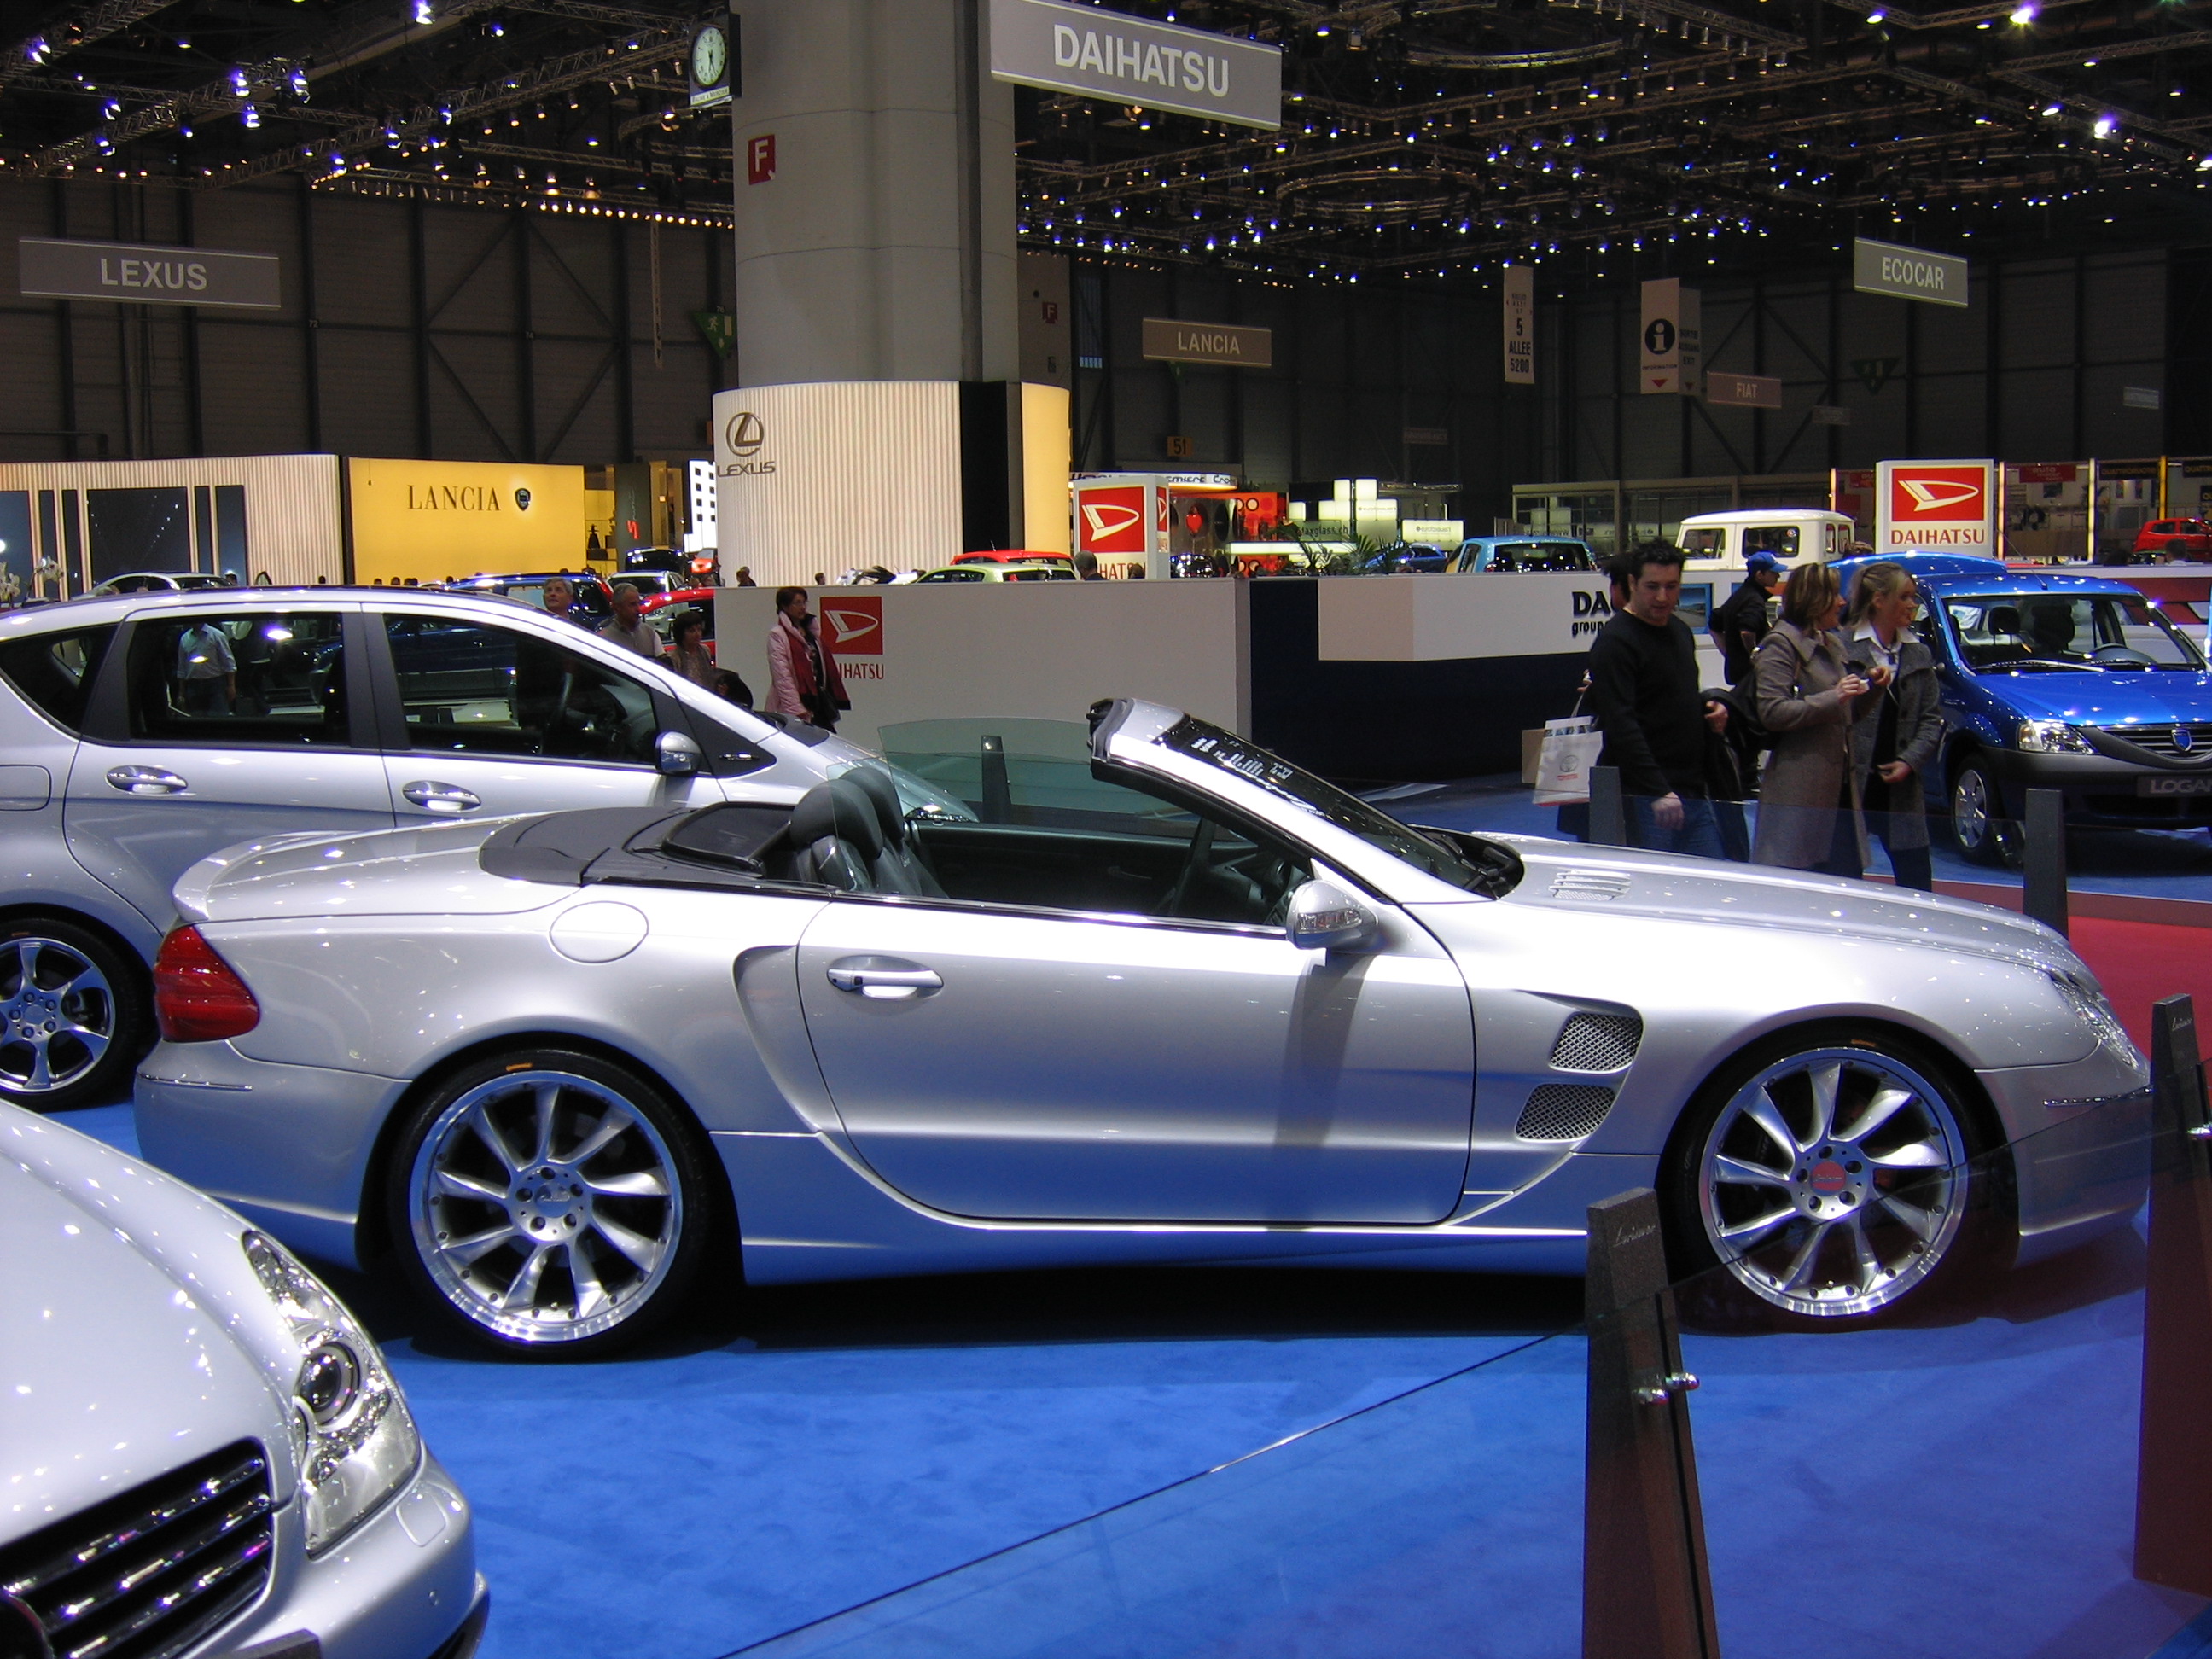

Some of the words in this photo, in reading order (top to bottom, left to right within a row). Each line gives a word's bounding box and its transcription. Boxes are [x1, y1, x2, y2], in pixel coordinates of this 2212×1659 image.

[1053, 24, 1230, 98] DAIHATSU
[754, 139, 769, 172] F
[100, 258, 207, 291] LEXUS
[1882, 256, 1944, 290] ECOCAR
[1516, 317, 1523, 336] 5
[1177, 331, 1241, 356] LANCIA
[1509, 341, 1531, 355] ALLEE
[1510, 358, 1529, 373] 5200
[1736, 382, 1758, 399] FIAT
[1173, 438, 1186, 455] 51
[717, 461, 776, 477] LEXUS
[407, 484, 501, 512] LANCIA
[1890, 529, 1985, 545] DAIHATSU
[1572, 591, 1612, 617] DA
[1572, 621, 1610, 638] group
[839, 663, 884, 680] IHATSU
